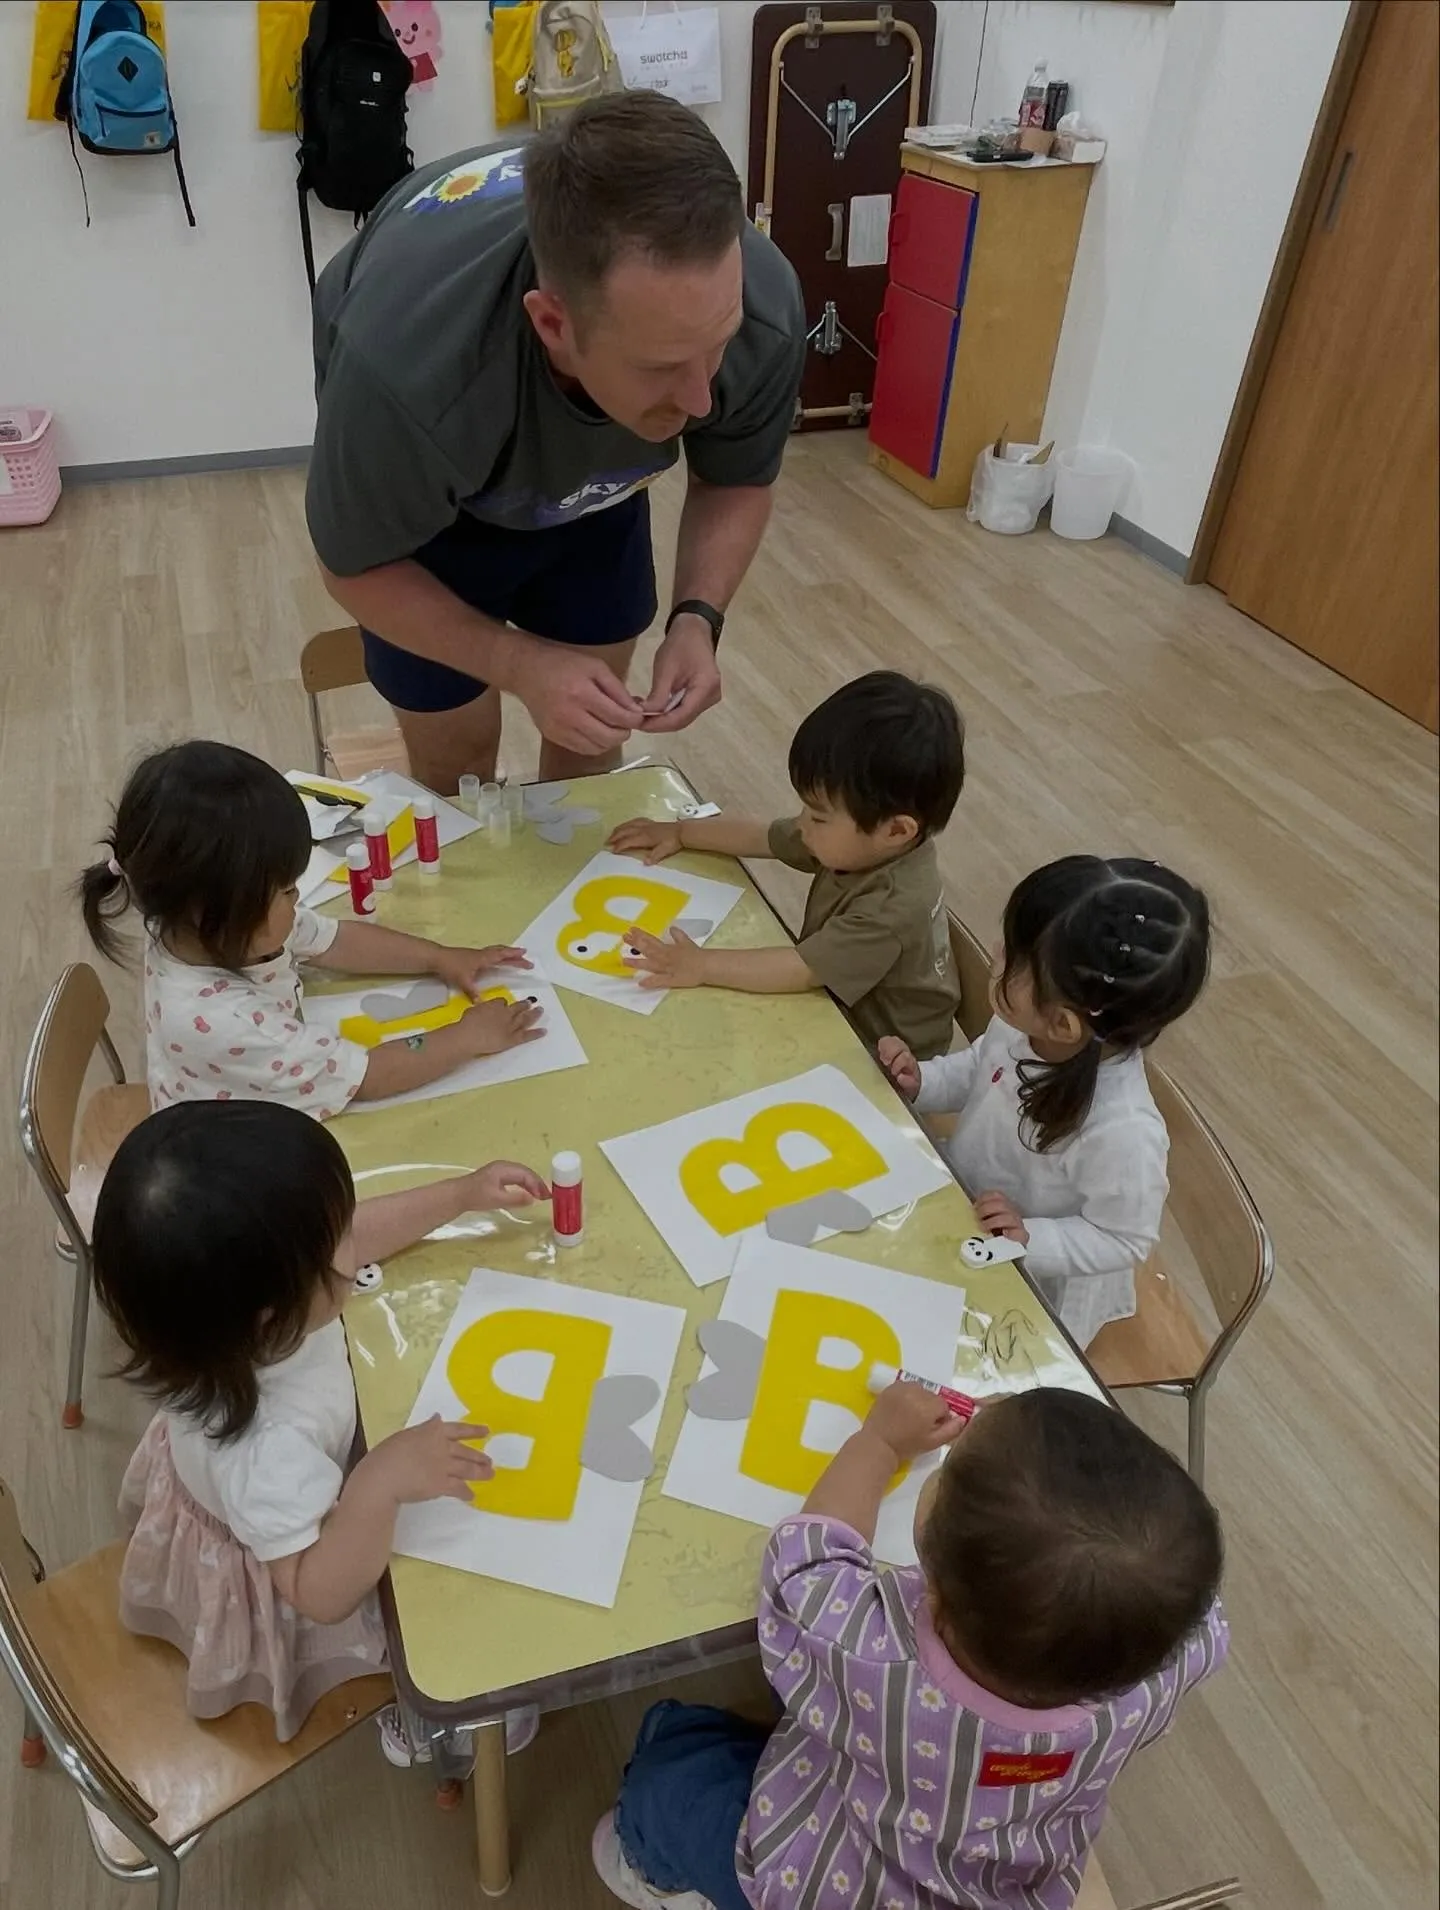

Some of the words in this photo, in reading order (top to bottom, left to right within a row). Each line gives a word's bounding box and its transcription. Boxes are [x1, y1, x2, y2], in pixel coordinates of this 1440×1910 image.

[678, 1102, 890, 1238] B
[446, 1308, 613, 1519] B
[739, 1286, 913, 1497] B
